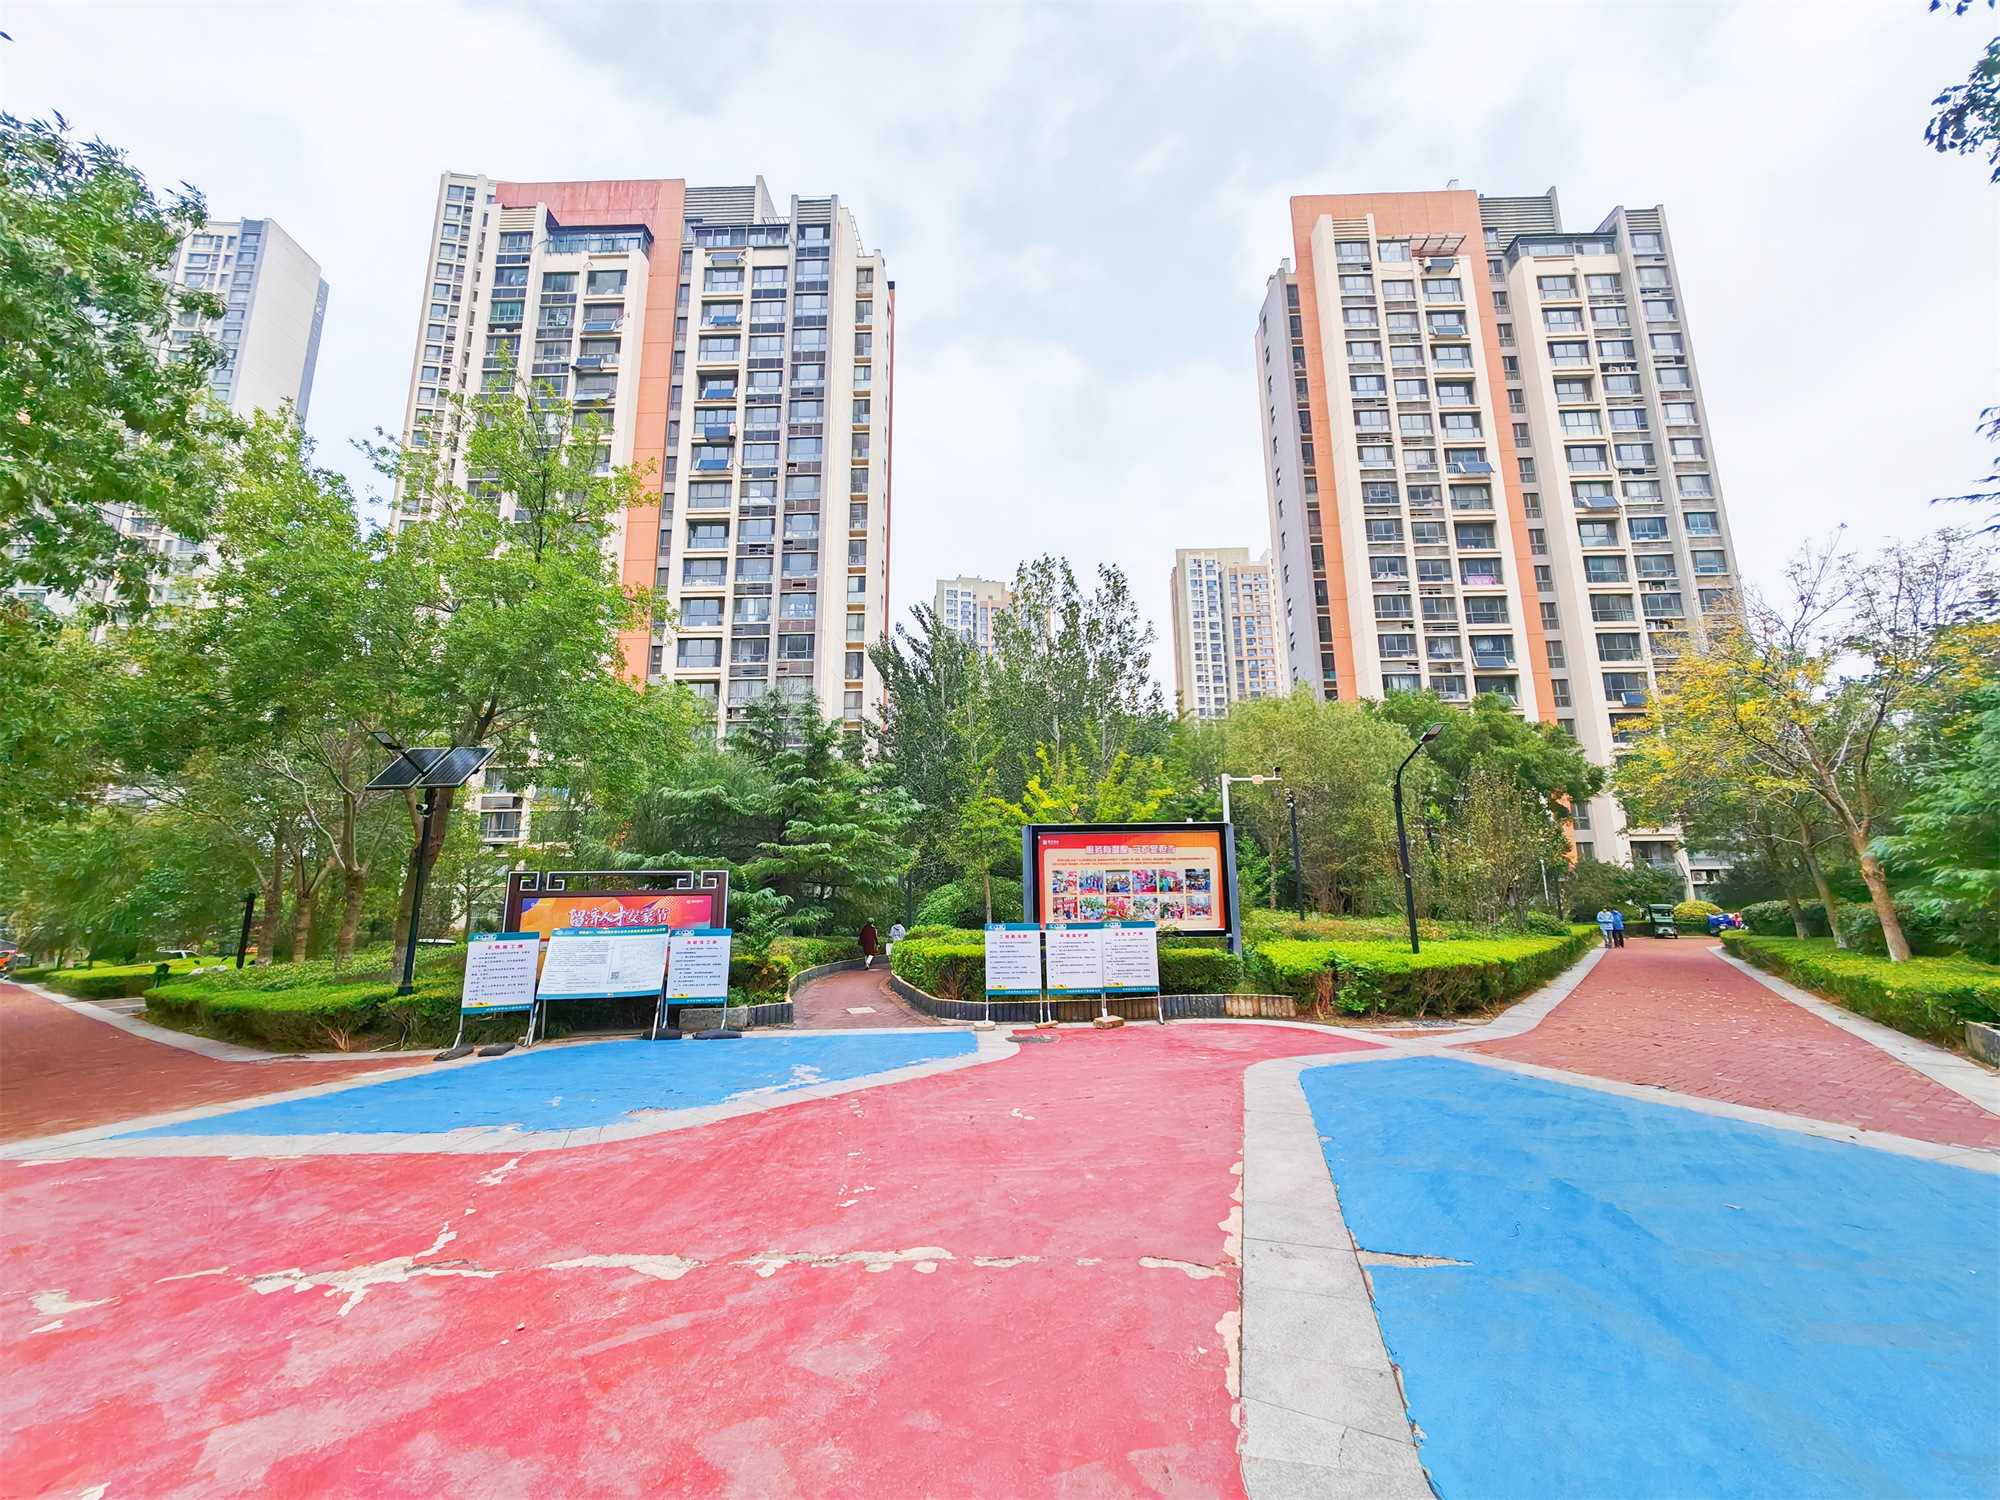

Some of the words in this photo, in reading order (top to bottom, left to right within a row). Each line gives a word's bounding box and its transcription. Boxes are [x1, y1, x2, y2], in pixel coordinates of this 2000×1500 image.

[1085, 844, 1129, 855] 服务有温度
[1132, 844, 1176, 855] 守护是担当
[568, 905, 669, 927] 留济人才安家节
